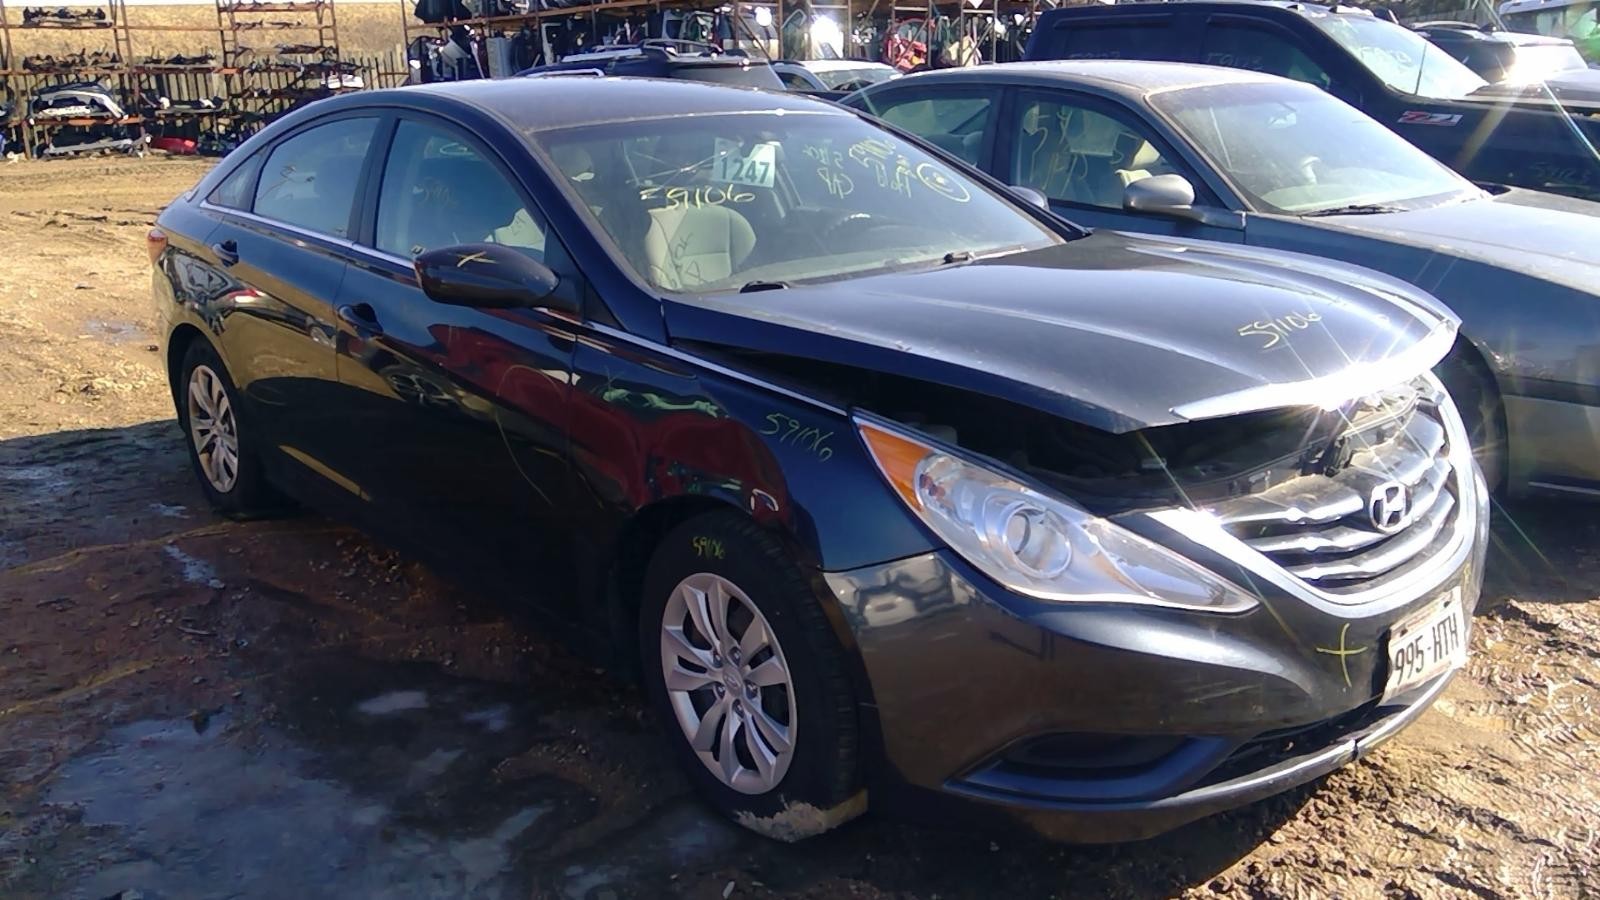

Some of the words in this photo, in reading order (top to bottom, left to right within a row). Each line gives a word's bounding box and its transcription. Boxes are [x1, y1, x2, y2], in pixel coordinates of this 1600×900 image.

[720, 157, 770, 184] 1247
[1238, 311, 1322, 349] 59106
[760, 413, 834, 462] 59106
[1395, 612, 1459, 686] 995-HTH
